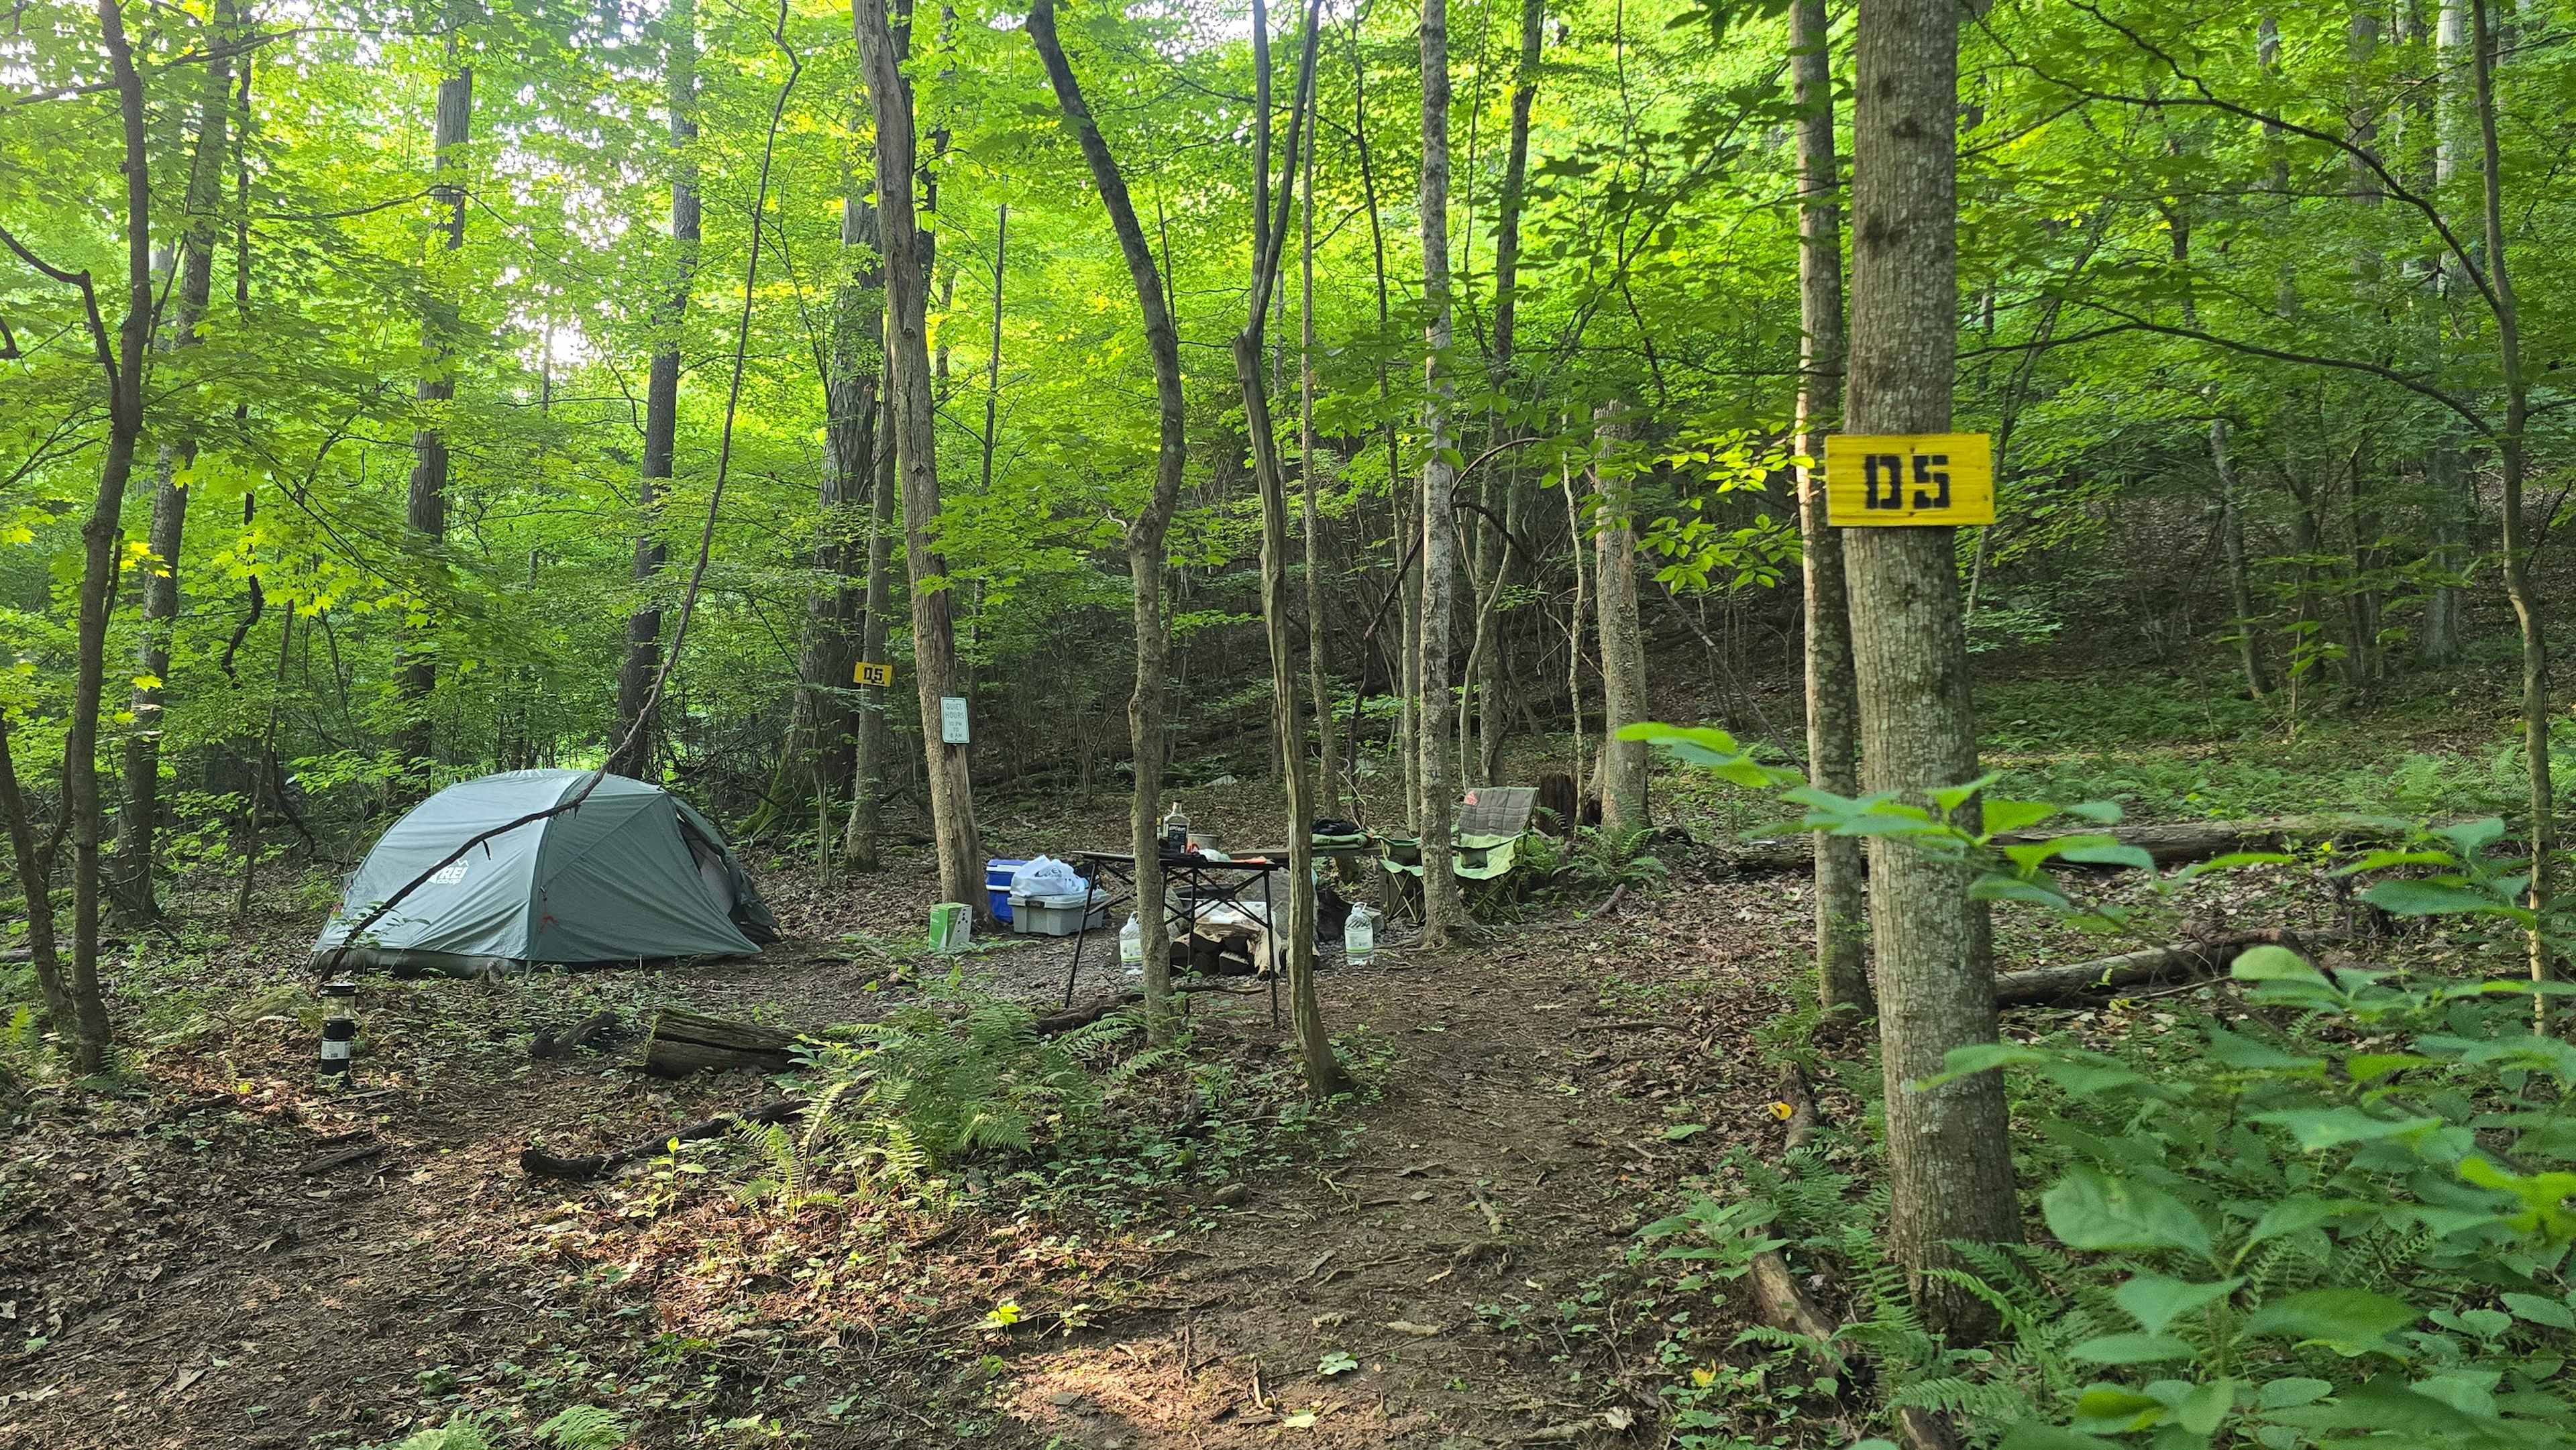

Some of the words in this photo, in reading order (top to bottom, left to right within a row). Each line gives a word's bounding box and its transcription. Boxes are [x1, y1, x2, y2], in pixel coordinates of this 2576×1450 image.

[1864, 454, 1951, 510] D5
[863, 667, 883, 681] D5
[946, 702, 961, 710] QUIET
[439, 867, 469, 879] REI
